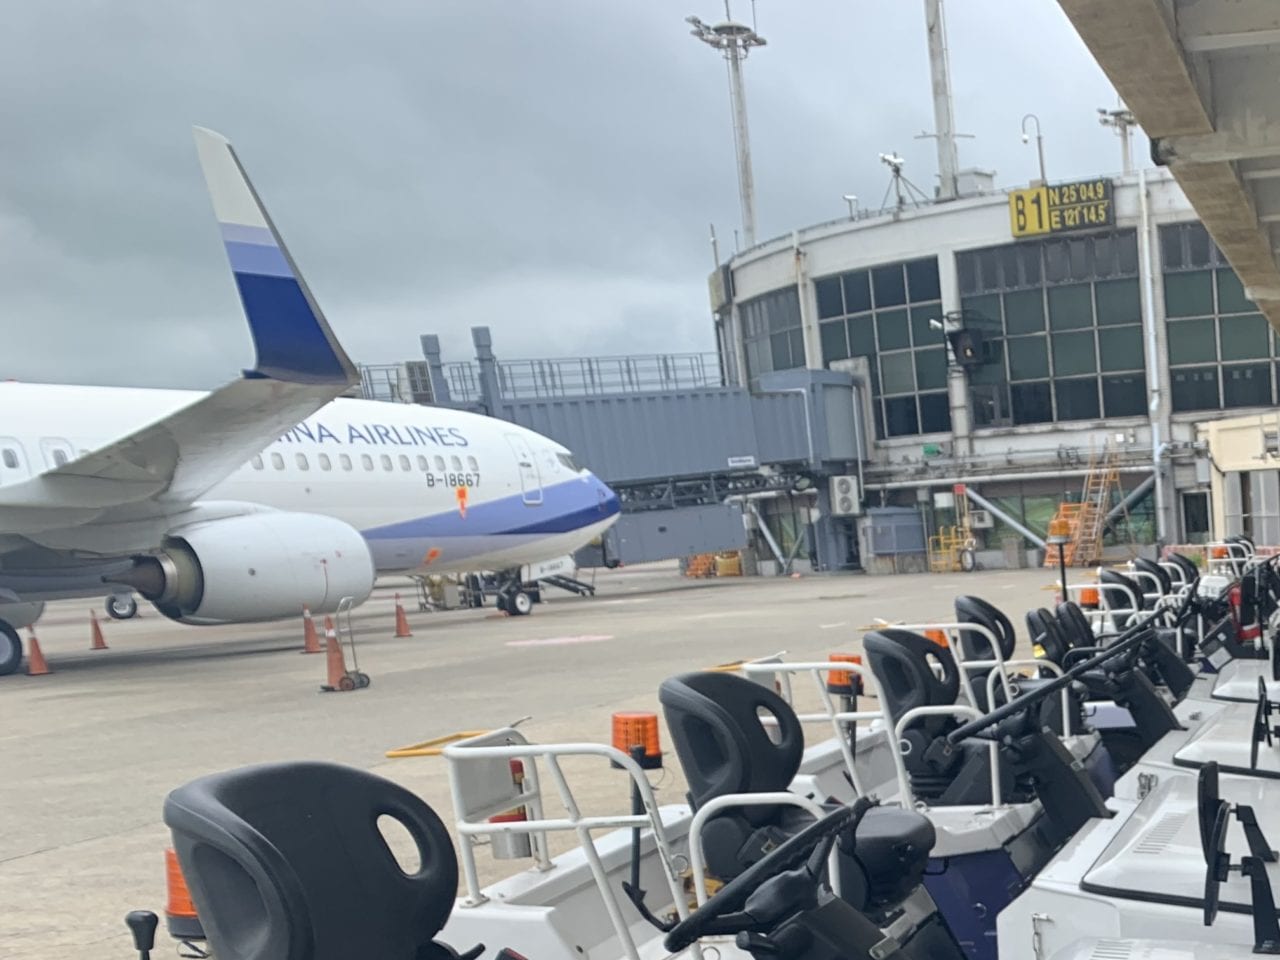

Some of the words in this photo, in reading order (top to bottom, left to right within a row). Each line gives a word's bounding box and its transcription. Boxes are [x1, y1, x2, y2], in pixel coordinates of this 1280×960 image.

[1049, 187, 1060, 206] N
[1016, 192, 1043, 231] B1
[1051, 210, 1061, 229] E
[348, 423, 469, 447] AIRLINES
[425, 472, 480, 488] B-18667
